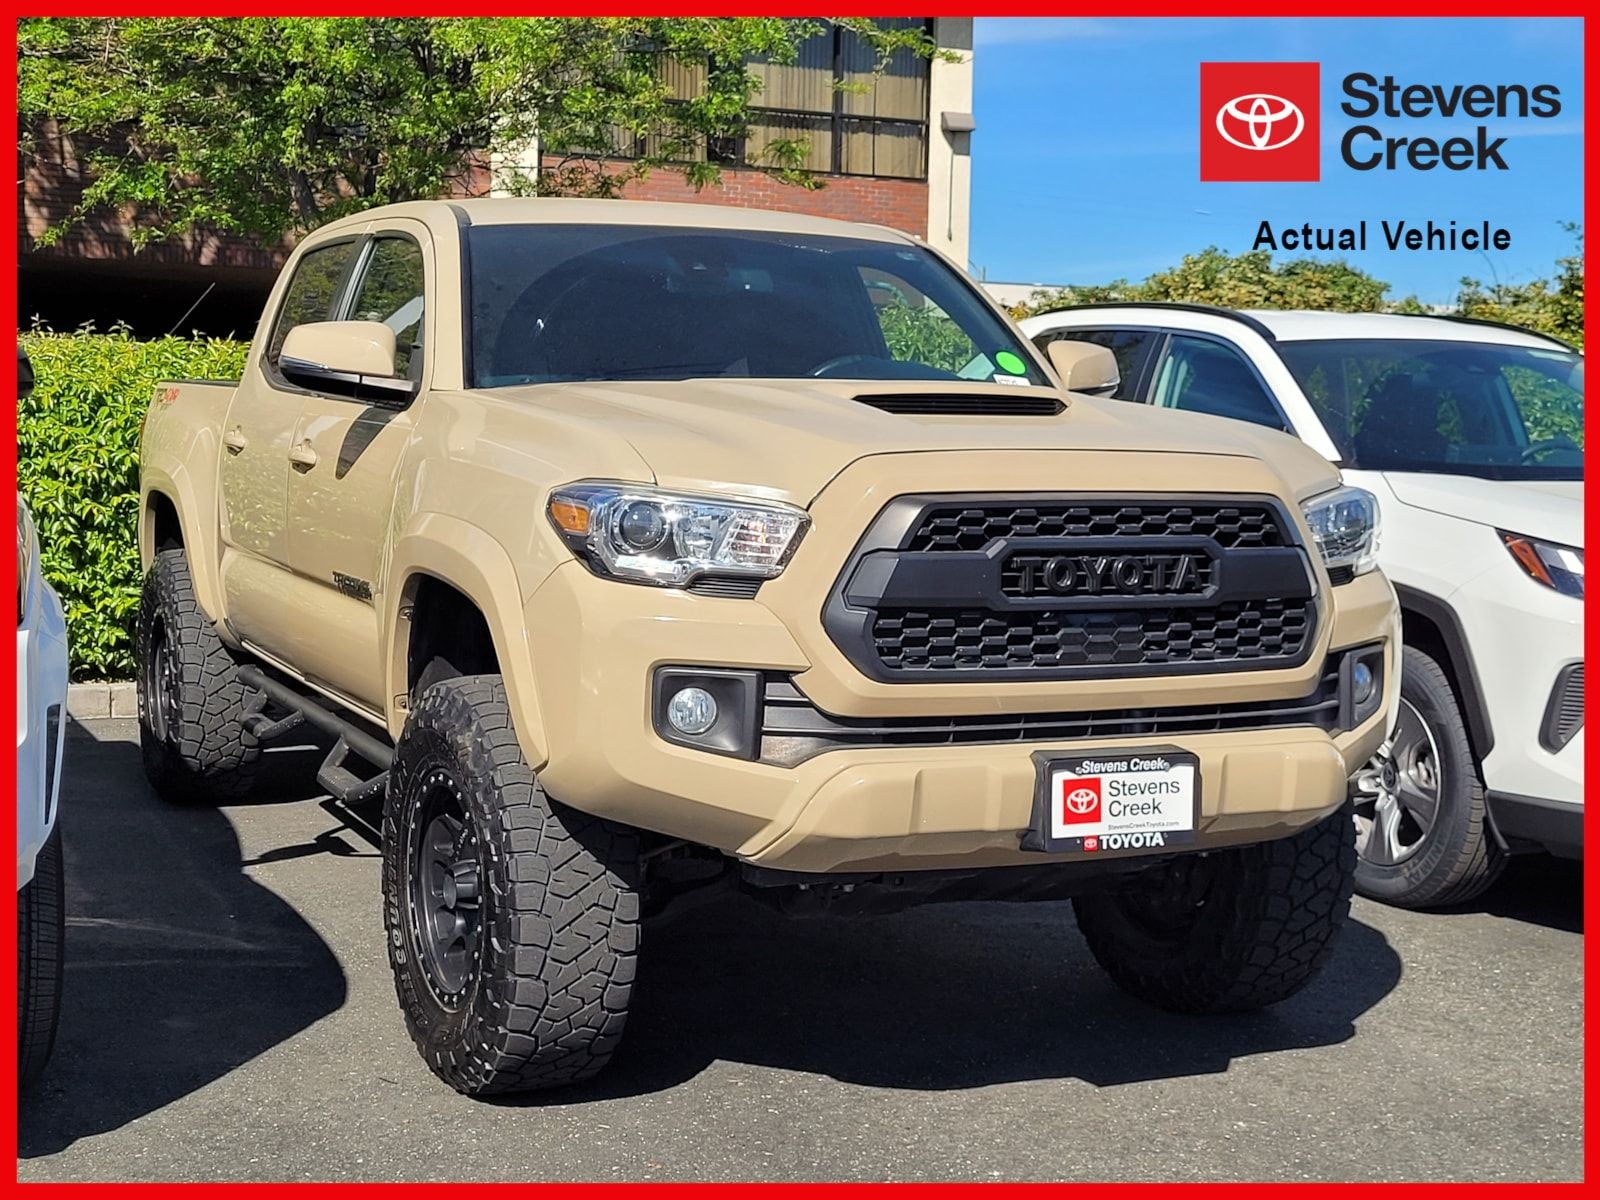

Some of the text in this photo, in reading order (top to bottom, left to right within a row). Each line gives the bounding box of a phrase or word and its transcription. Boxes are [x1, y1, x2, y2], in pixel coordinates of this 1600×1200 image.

[1011, 554, 1203, 593] TOYOTA
[1081, 757, 1165, 774] Stevens Creek
[1108, 780, 1180, 797] Stevens
[1108, 798, 1162, 817] Creek
[1108, 821, 1180, 831] StevensCreekToyota.com
[1100, 832, 1165, 850] TOYOTA
